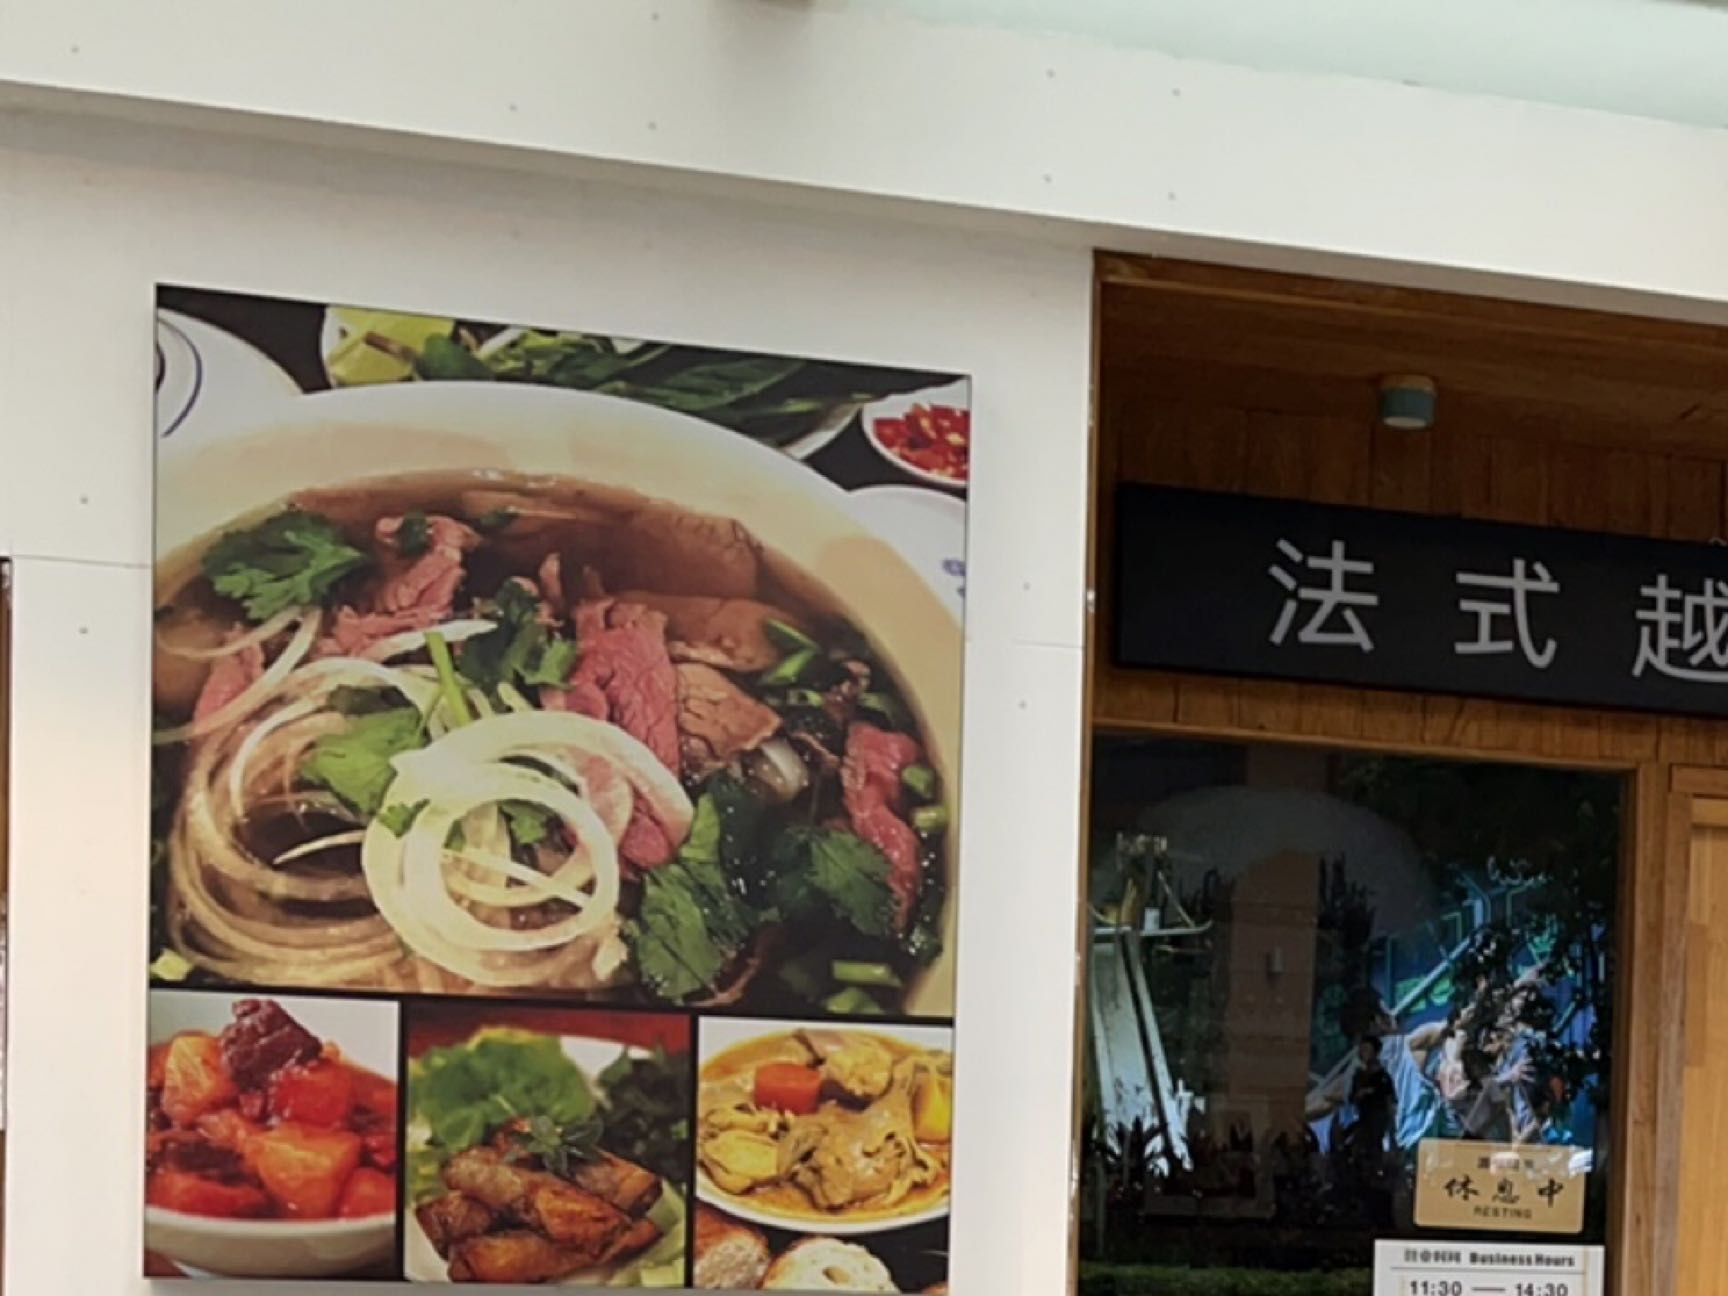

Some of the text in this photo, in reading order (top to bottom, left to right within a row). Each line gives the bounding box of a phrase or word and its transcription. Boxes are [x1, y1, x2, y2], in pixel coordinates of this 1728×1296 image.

[1444, 1174, 1564, 1209] 休息中
[1469, 1252, 1532, 1267] Business
[1534, 1253, 1576, 1267] Hours
[1409, 1280, 1463, 1296] 11:30
